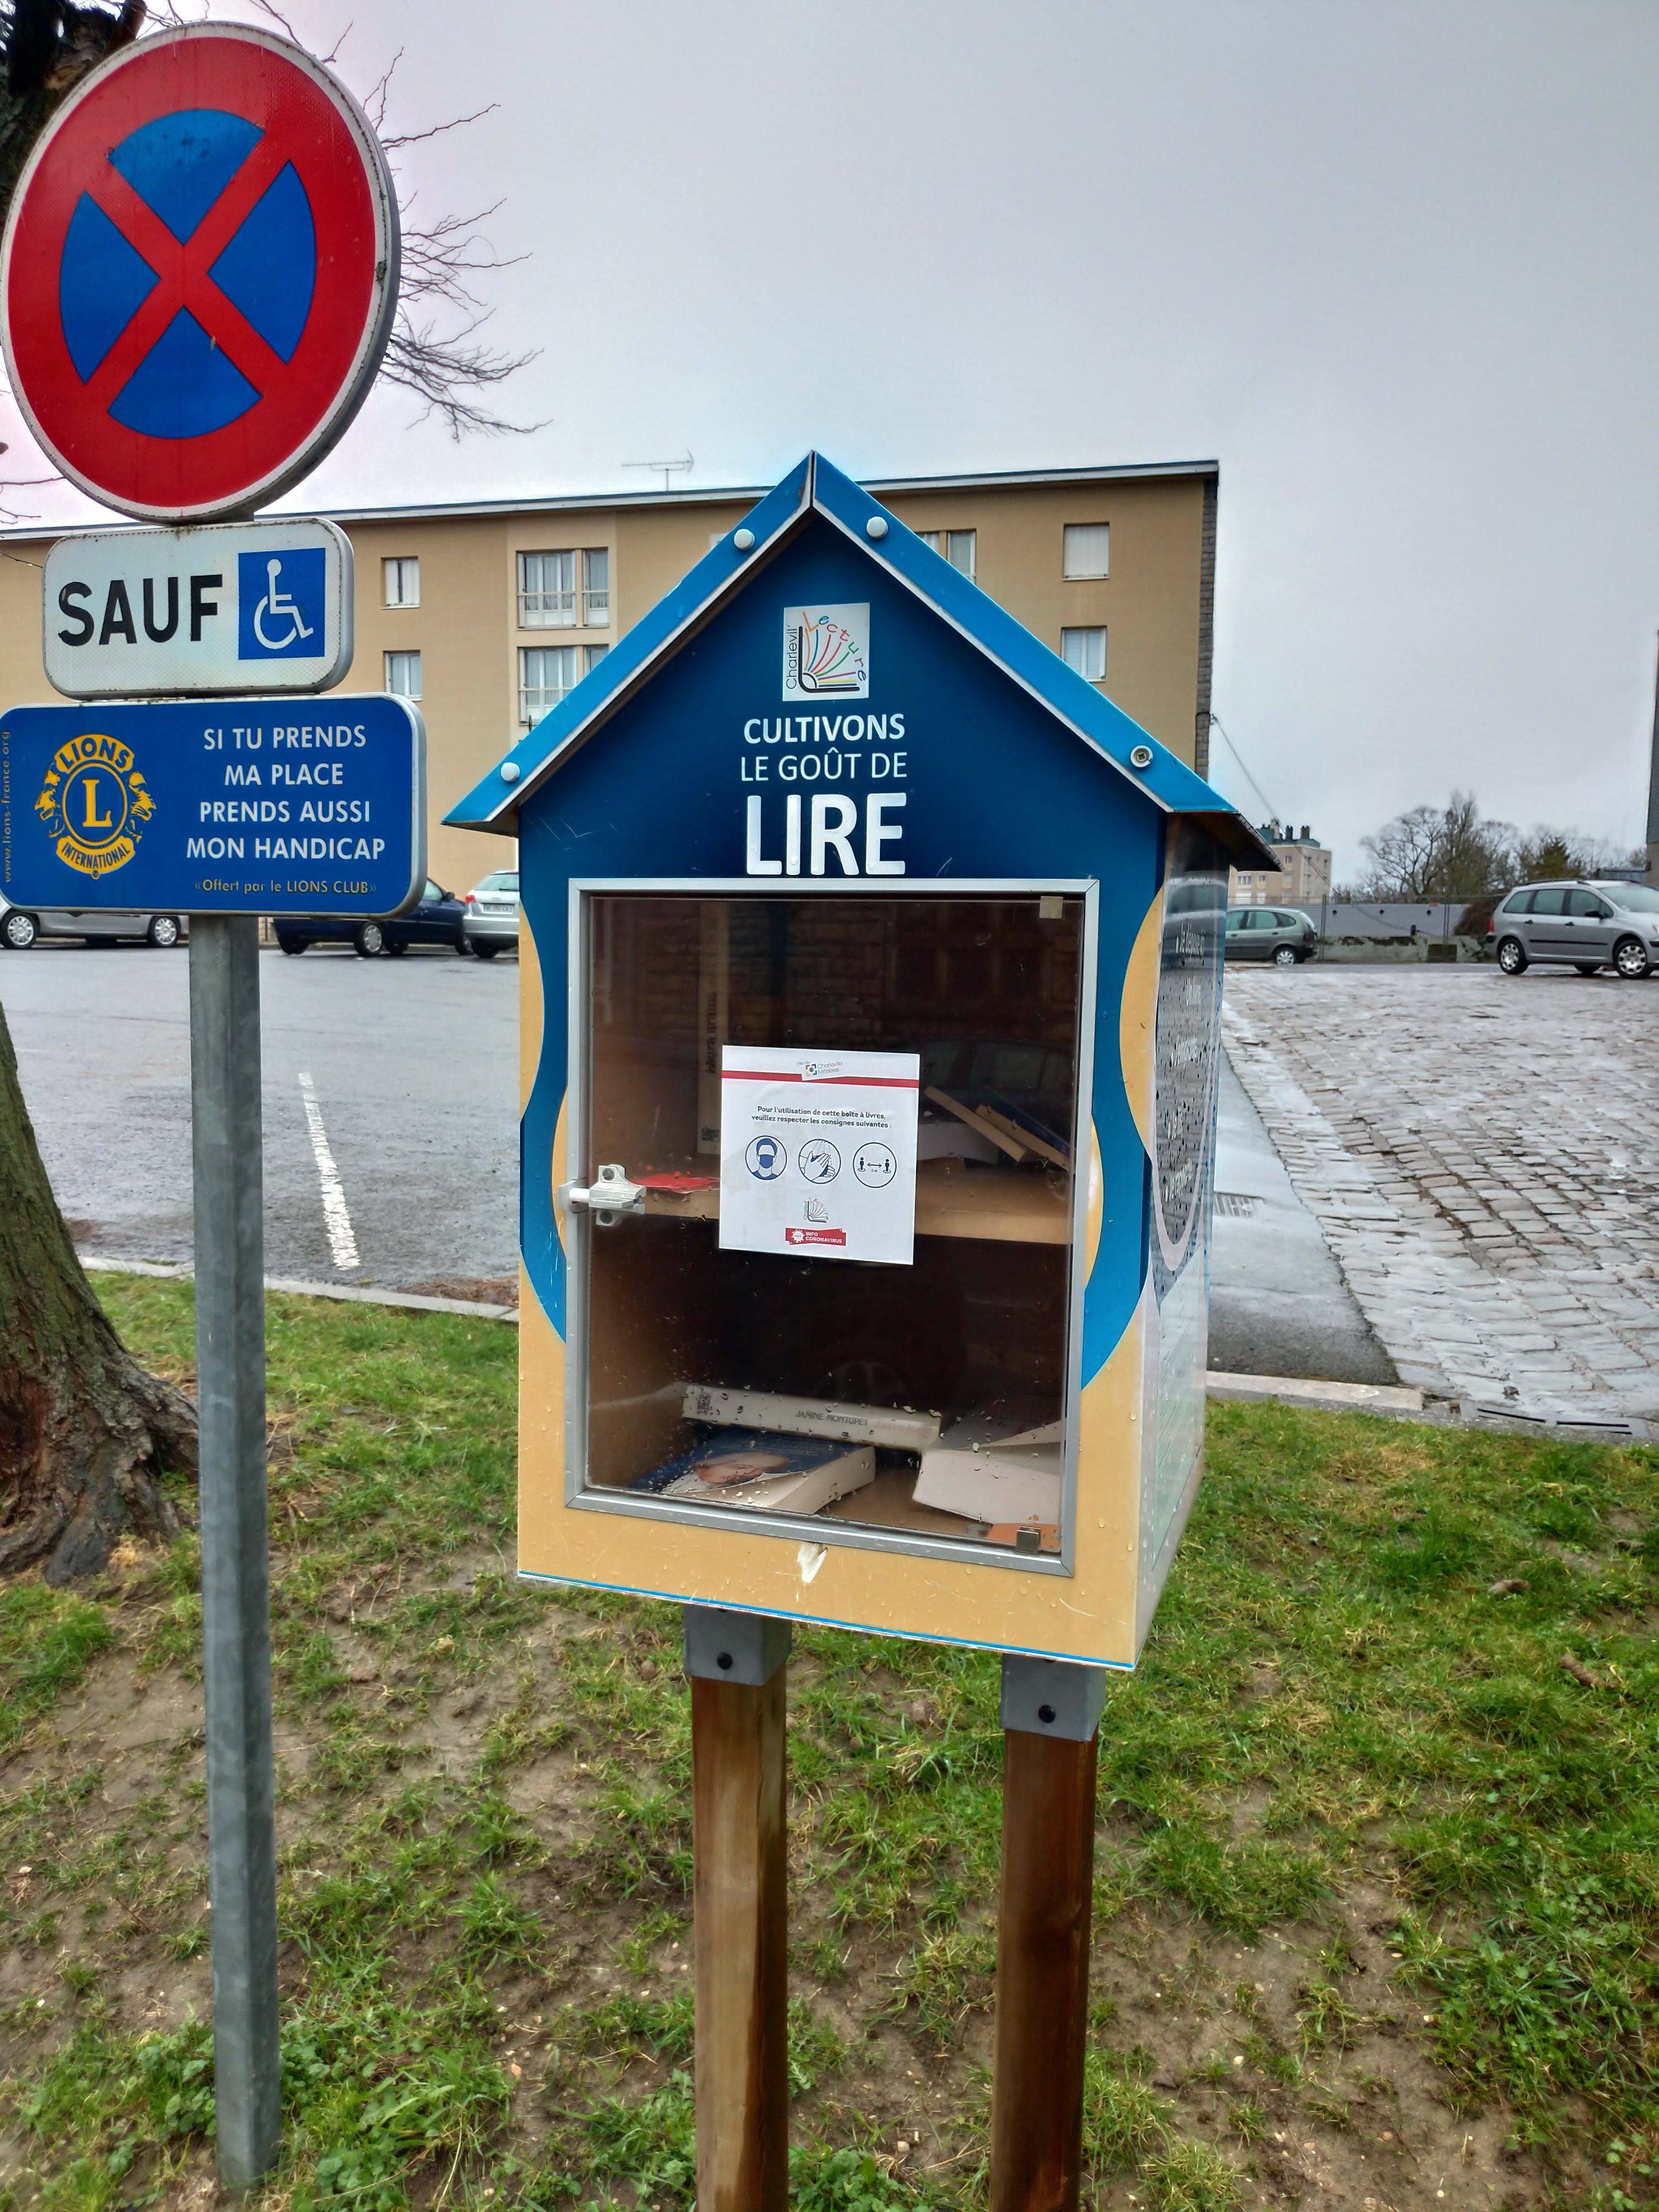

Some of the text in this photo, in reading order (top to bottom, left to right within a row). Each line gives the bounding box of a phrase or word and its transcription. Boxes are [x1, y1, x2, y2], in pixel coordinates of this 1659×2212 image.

[58, 574, 223, 646] SAUF
[803, 611, 866, 681] Lecture
[204, 725, 366, 749] SI TU PRENDS
[743, 714, 905, 744] CULTIVONS
[59, 737, 130, 770] LIONS
[741, 747, 907, 781] LE GOÛT DE
[224, 763, 343, 786] MA PLACE
[2, 731, 11, 882] www.lions-france.org
[82, 779, 112, 827] L
[200, 800, 370, 822] PRENDS AUSSI
[747, 793, 907, 876] LIRE
[61, 842, 130, 869] INTERNATIONAL
[187, 837, 385, 860] MON HANDICAP
[244, 882, 265, 895] par
[271, 879, 281, 892] le
[287, 880, 328, 893] LIONS
[774, 1107, 811, 1115] l'utilisation
[821, 1119, 855, 1127] consignes
[795, 1410, 868, 1426] JANINE MONTUPET
